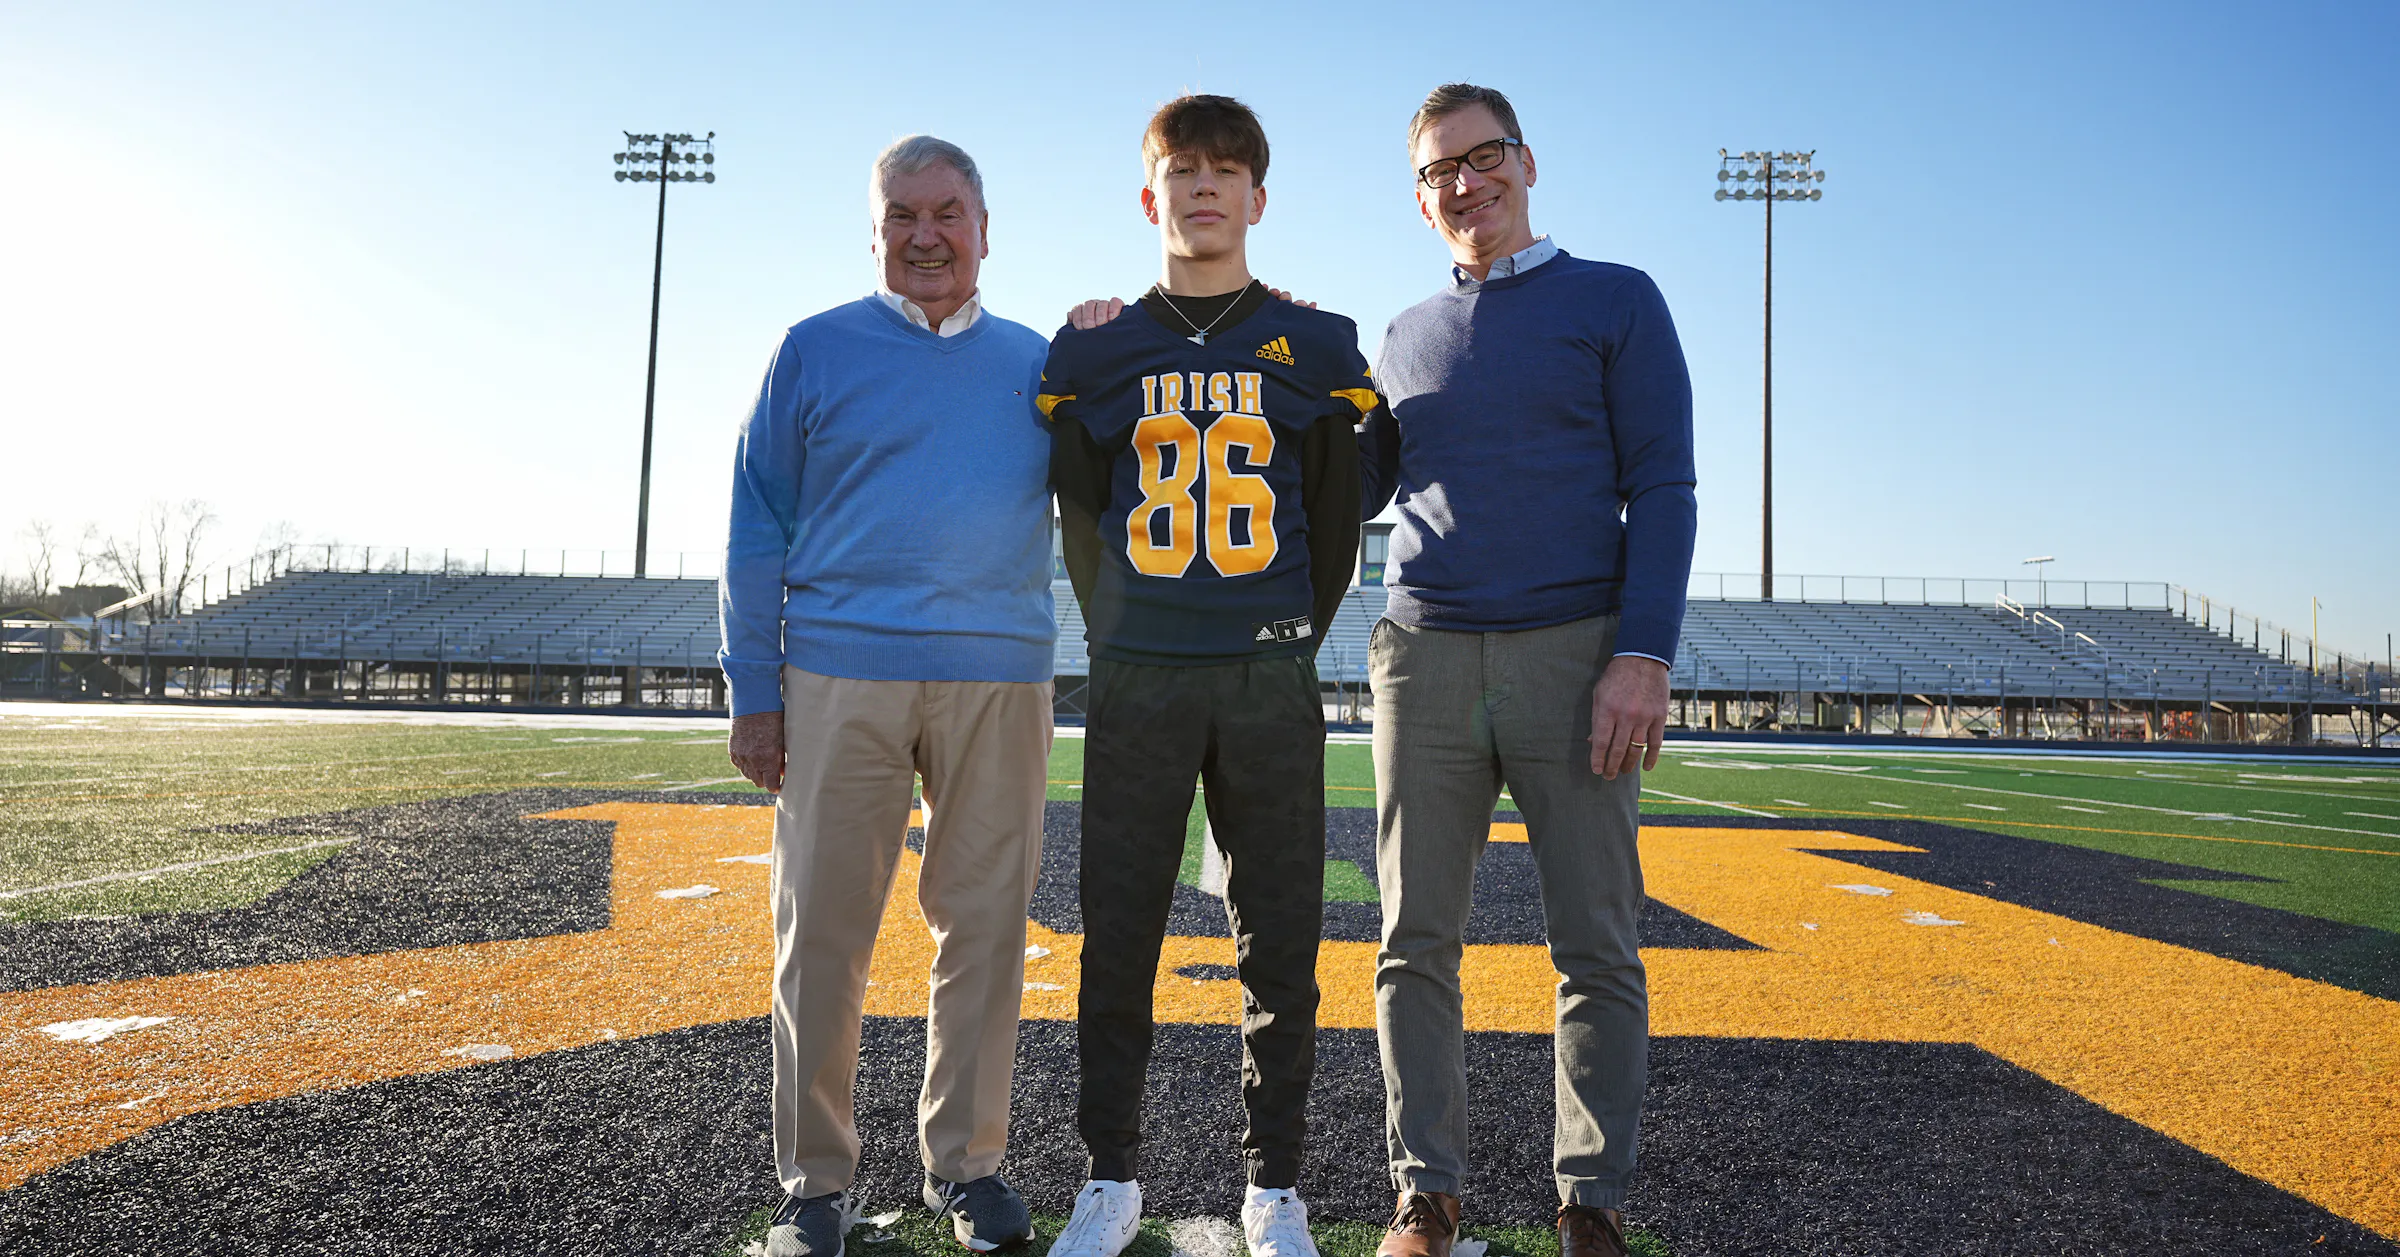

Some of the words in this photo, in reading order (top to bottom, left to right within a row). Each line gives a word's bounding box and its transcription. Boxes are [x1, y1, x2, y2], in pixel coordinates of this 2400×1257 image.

[1255, 349, 1295, 366] adidas
[1141, 371, 1264, 415] IRISH
[1126, 410, 1279, 579] 86
[1255, 633, 1275, 641] adidas
